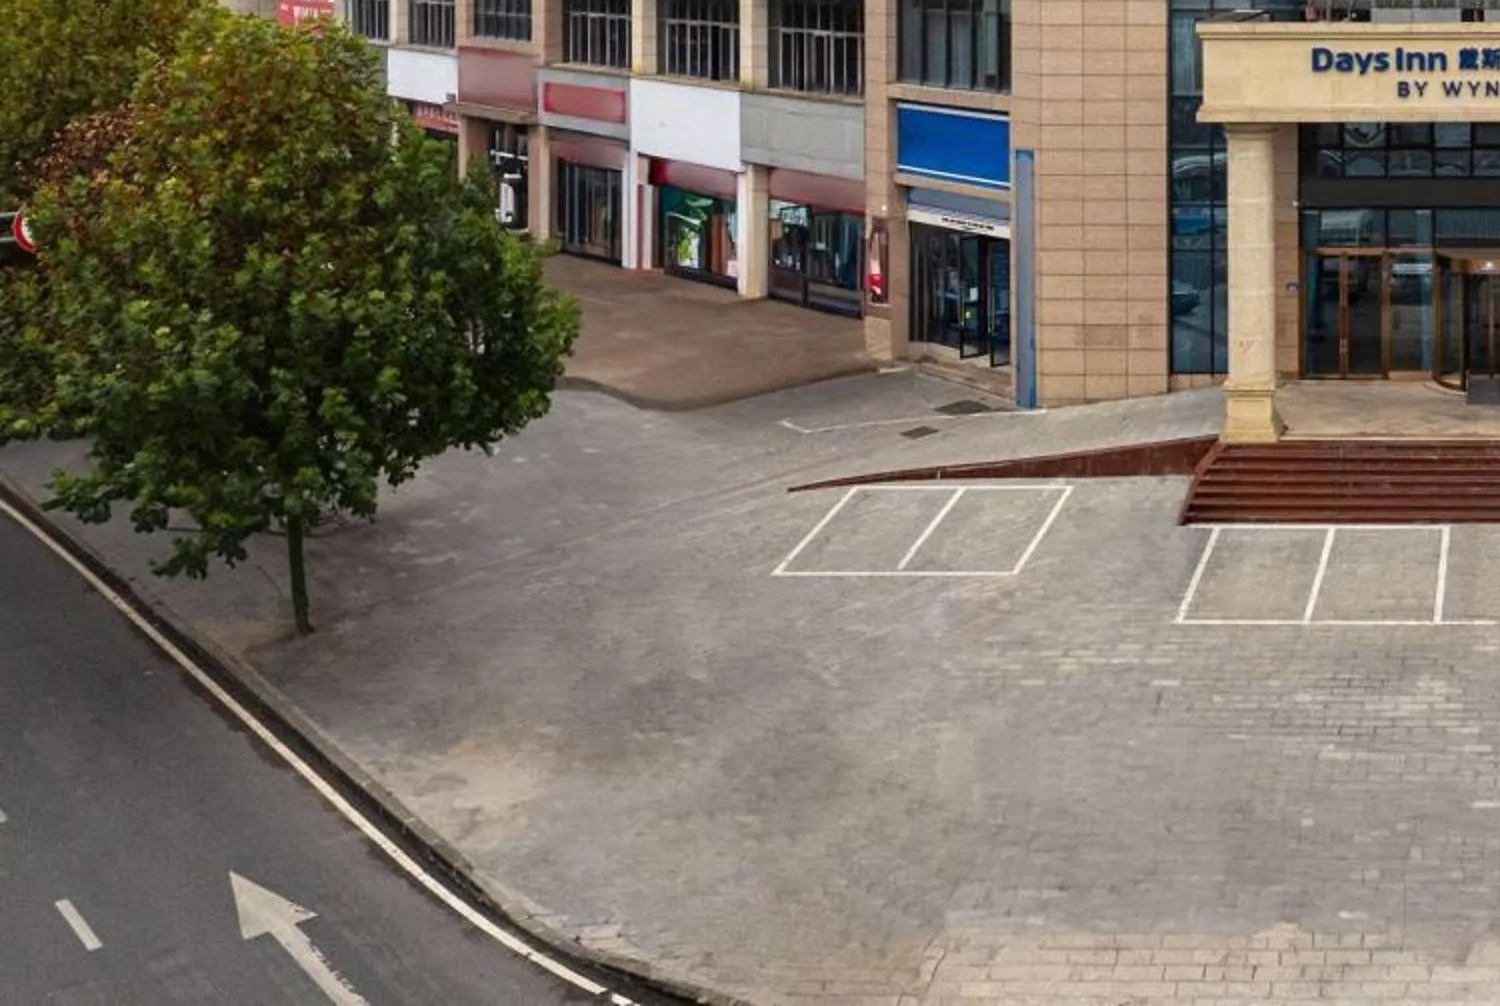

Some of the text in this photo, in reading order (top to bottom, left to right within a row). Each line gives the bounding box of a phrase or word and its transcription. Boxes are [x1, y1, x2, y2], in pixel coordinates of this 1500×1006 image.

[1312, 47, 1447, 74] Days Inn
[1398, 80, 1428, 97] BY
